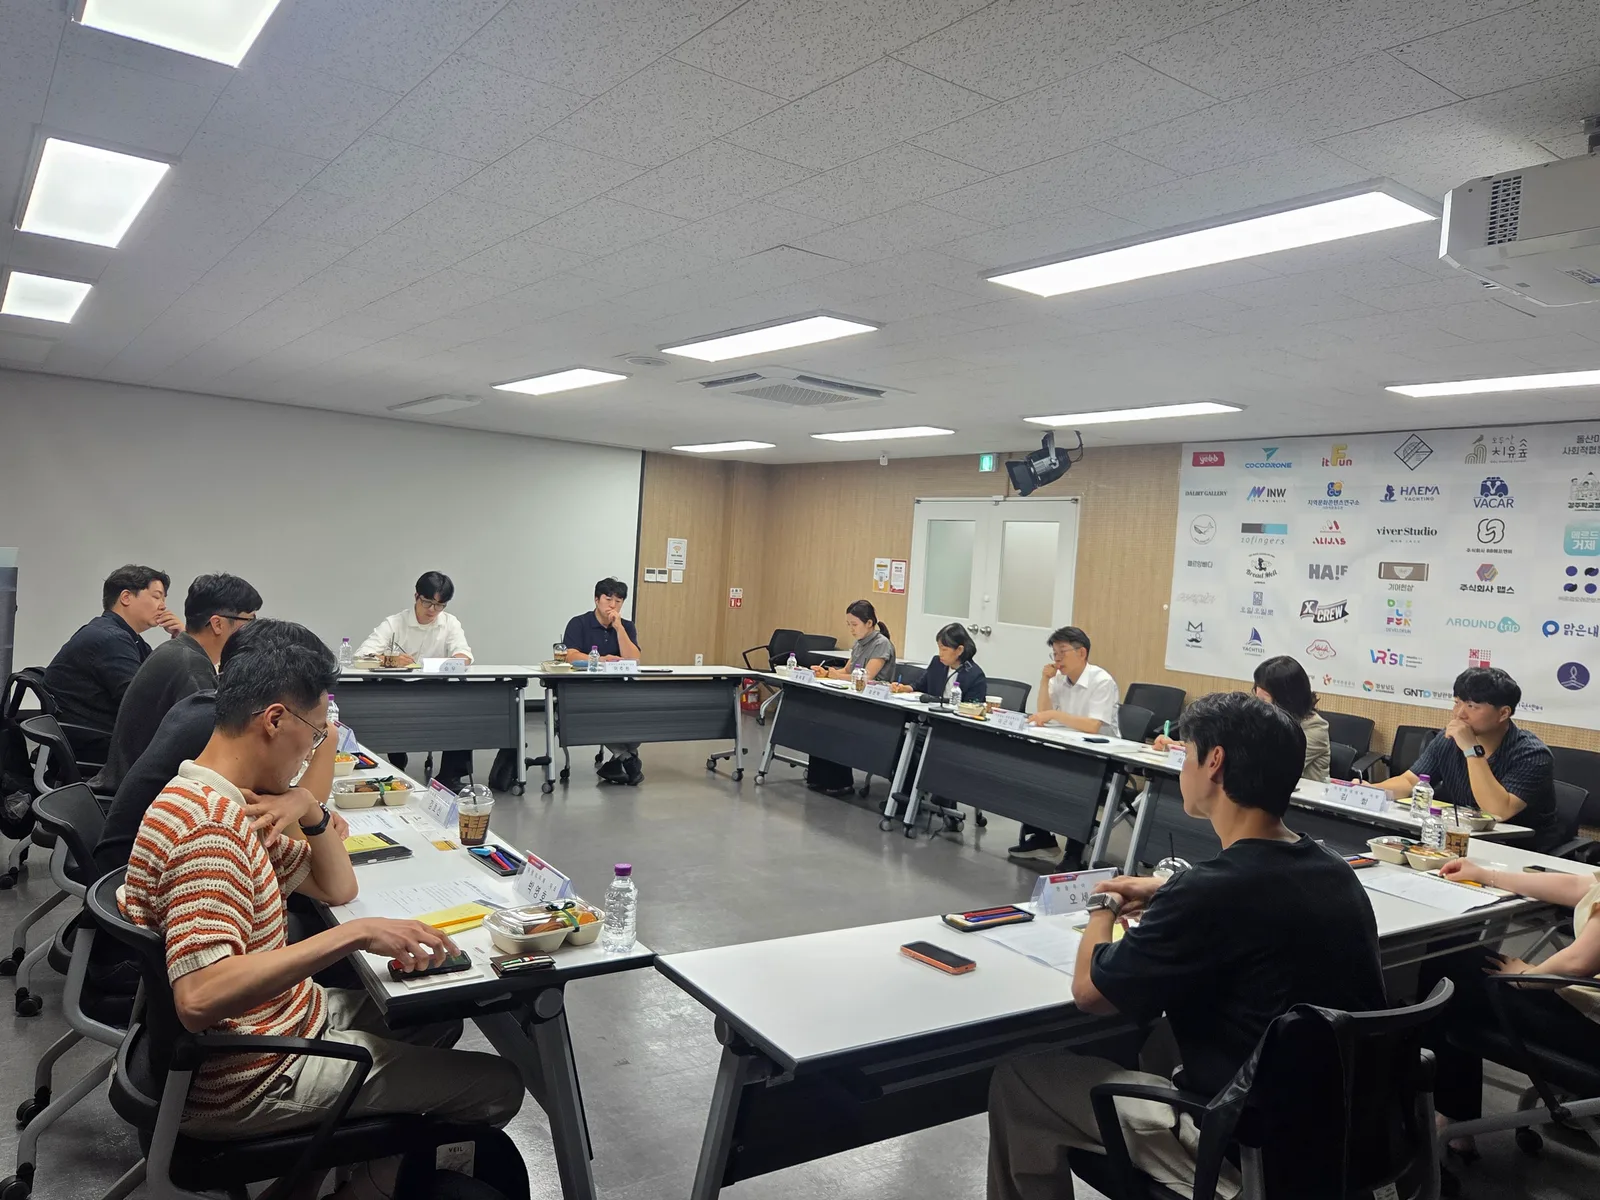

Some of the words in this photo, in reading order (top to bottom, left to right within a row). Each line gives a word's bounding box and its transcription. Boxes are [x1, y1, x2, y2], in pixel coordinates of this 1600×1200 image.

[1473, 498, 1514, 509] VACAR
[1459, 583, 1494, 594] 주식회사
[1317, 606, 1343, 622] CREW
[1445, 617, 1497, 630] AROUND
